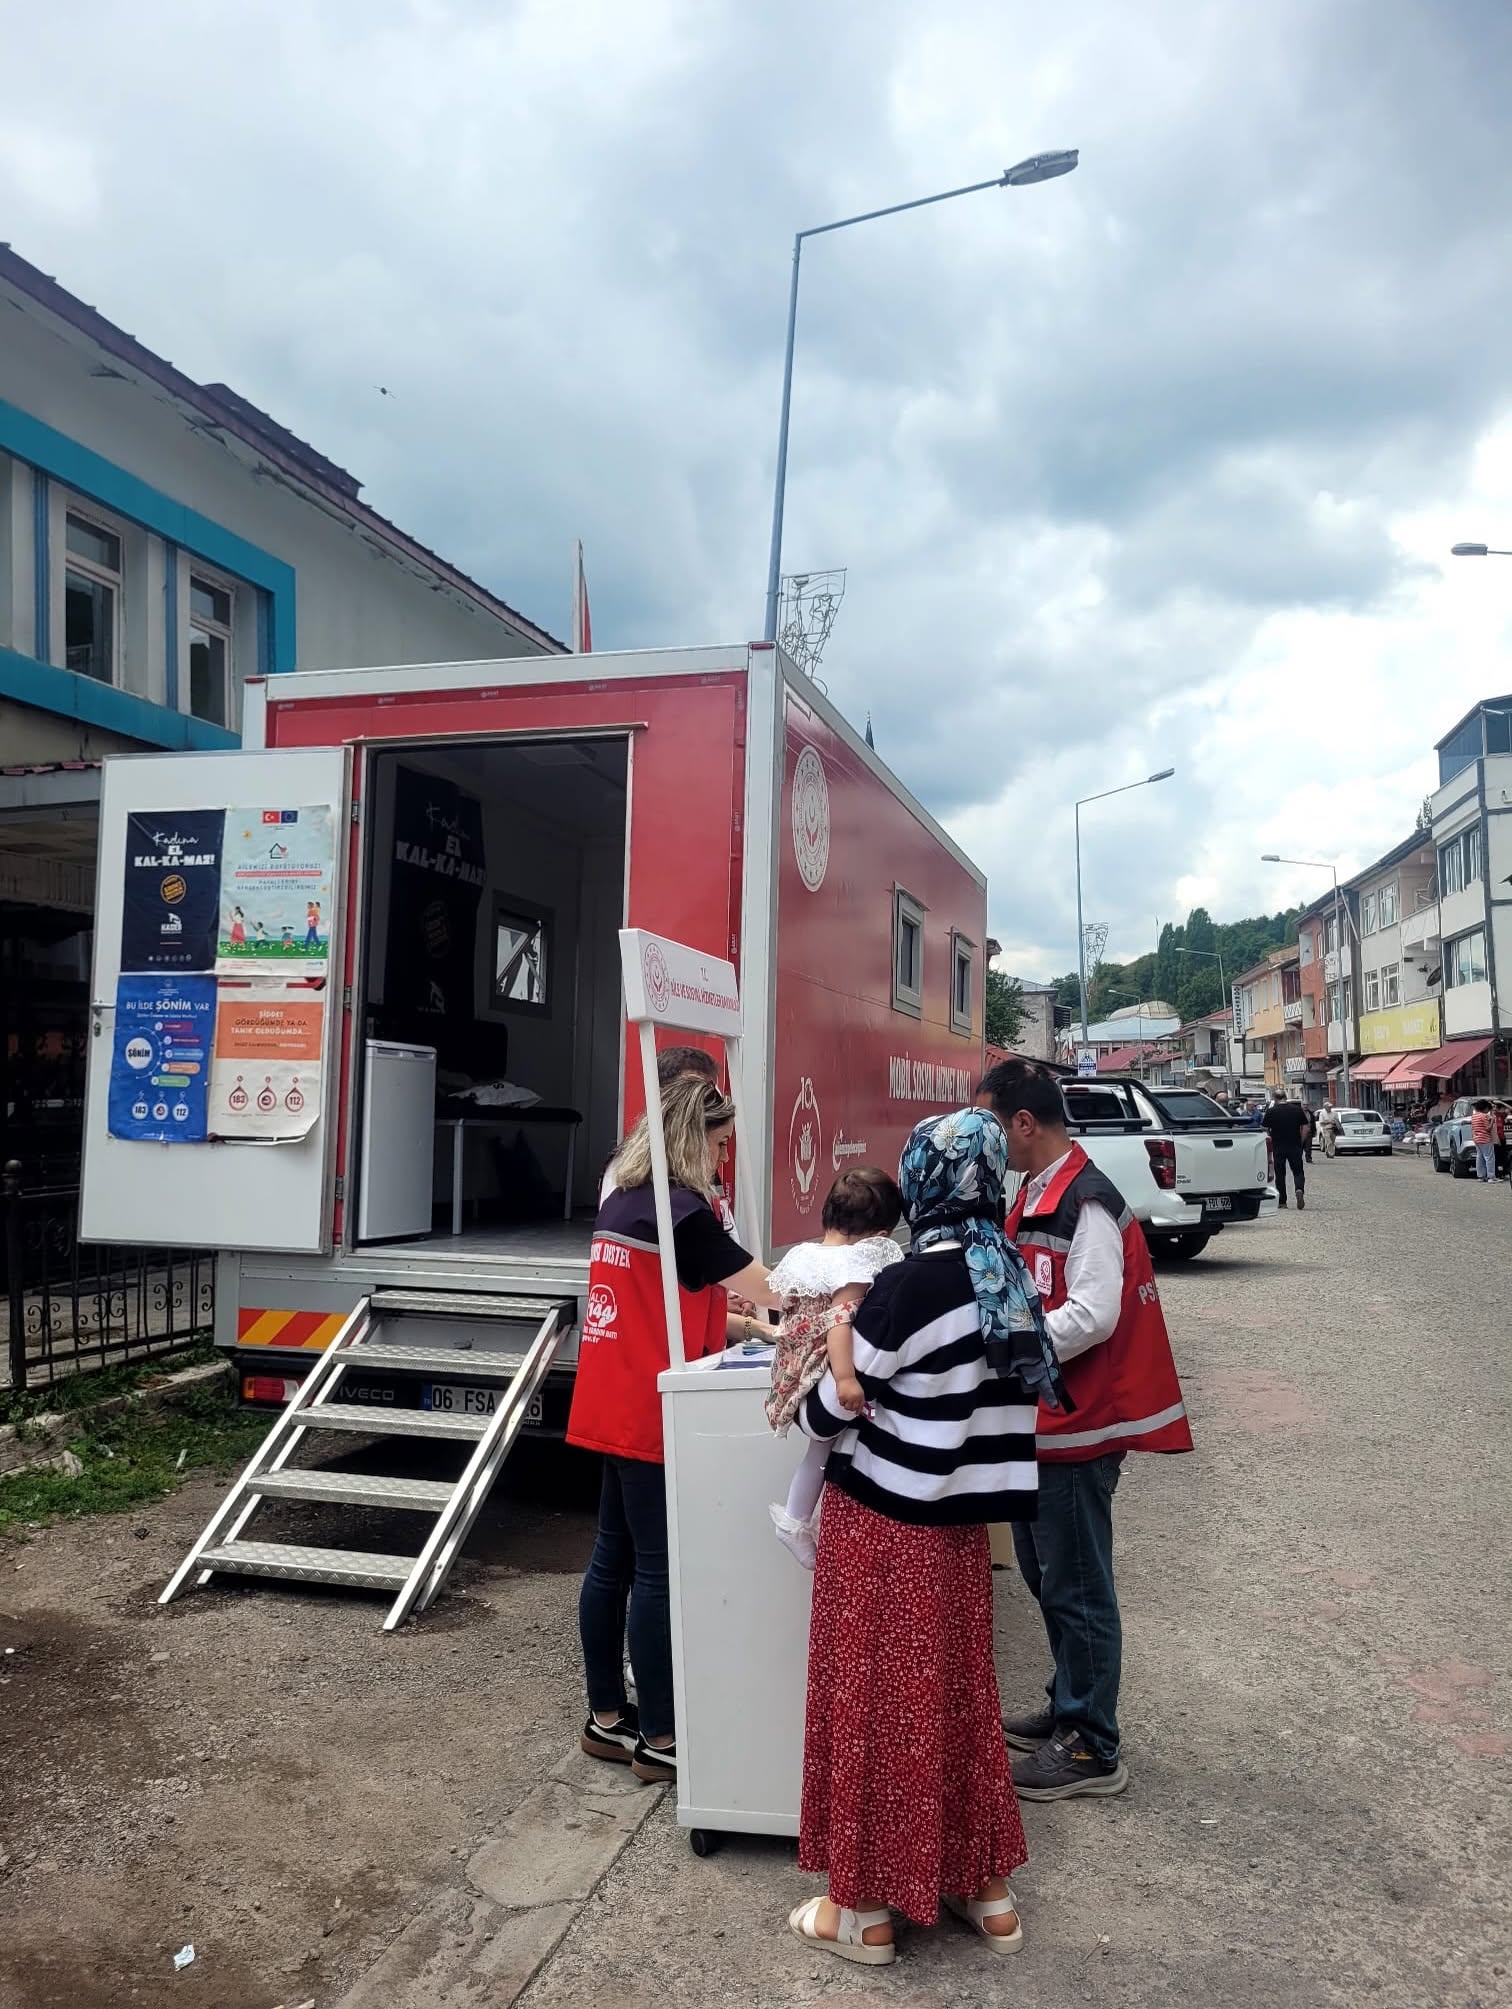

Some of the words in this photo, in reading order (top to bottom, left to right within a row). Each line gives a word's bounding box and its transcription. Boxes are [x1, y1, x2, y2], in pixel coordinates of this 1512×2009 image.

[168, 845, 183, 856] EL
[134, 854, 215, 867] KAL-KA-MAZ!
[126, 1001, 136, 1010] BU
[156, 998, 192, 1012] ŞÖNİM
[194, 1002, 210, 1011] VAR
[128, 1048, 150, 1058] ŞÖNİM
[889, 1052, 912, 1099] MOBİL
[913, 1061, 935, 1101] SOSYAL
[233, 1095, 245, 1103] 183
[289, 1096, 300, 1105] 112
[135, 1106, 146, 1114] 183
[176, 1108, 187, 1116] 112
[591, 1292, 608, 1303] ALO
[588, 1302, 613, 1320] 144
[339, 1387, 394, 1400] IVECO
[433, 1388, 453, 1409] 06
[464, 1390, 496, 1413] FSA
